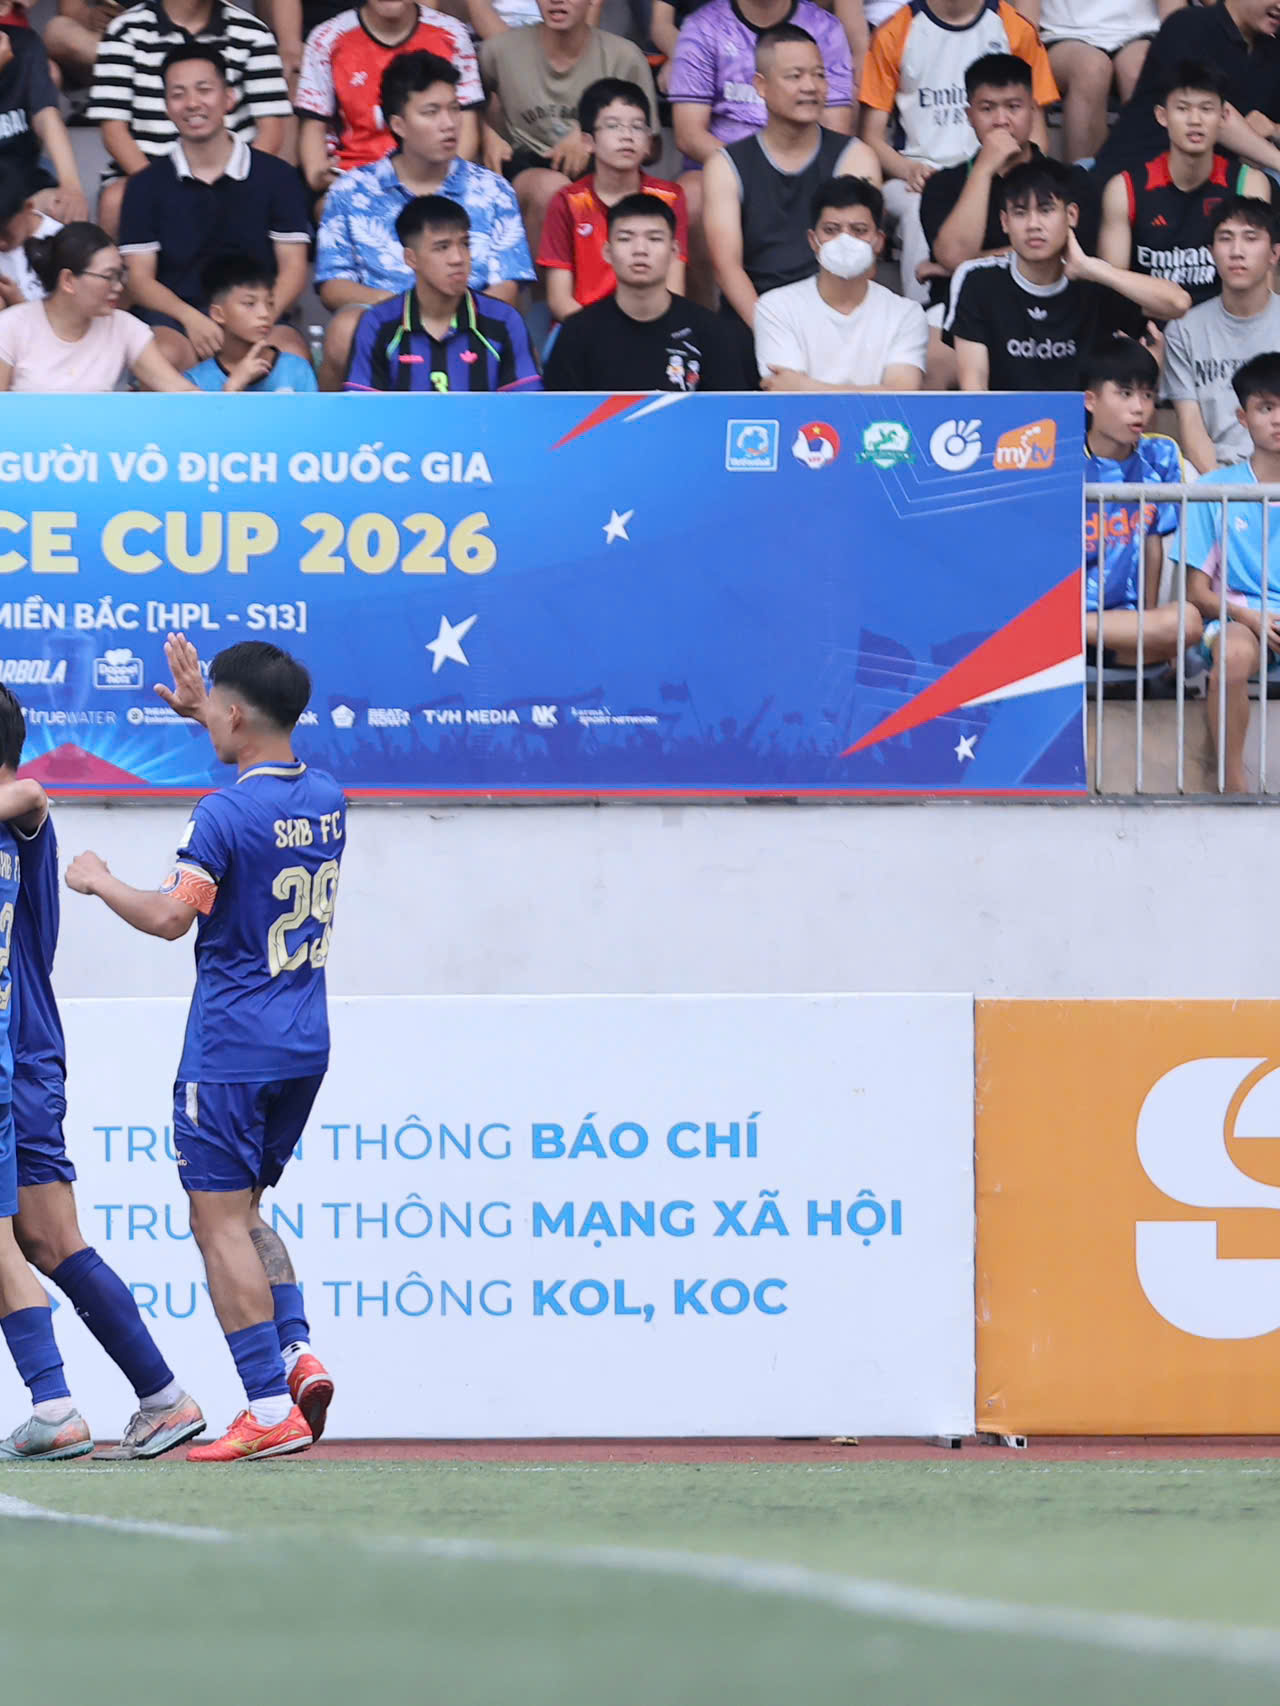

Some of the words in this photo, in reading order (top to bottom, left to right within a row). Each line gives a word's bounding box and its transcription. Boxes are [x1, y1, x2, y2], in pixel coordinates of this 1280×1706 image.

[109, 443, 168, 483] VÔ
[178, 451, 277, 492] ĐỊCH
[289, 441, 410, 483] QUỐC
[422, 451, 492, 483] GIA
[996, 442, 1055, 469] mytv
[101, 510, 279, 574] CUP
[299, 512, 497, 575] 2026
[74, 595, 139, 630] BẮC
[147, 601, 219, 632] [HPL
[247, 601, 307, 632] S13]
[465, 709, 520, 724] MEDIA
[273, 819, 313, 848] SHB
[320, 810, 342, 844] FC
[268, 859, 340, 978] 29
[322, 1114, 512, 1162] THÔNG
[531, 1111, 649, 1161] BÁO
[666, 1111, 761, 1160] CHÍ
[94, 1202, 305, 1241] TRUN
[322, 1192, 512, 1241] THÔNG
[531, 1199, 696, 1249] MẠNG
[714, 1189, 791, 1238] XÃ
[807, 1189, 903, 1248] HỘI
[322, 1271, 512, 1318] THÔNG
[532, 1279, 656, 1325] KOL,
[674, 1277, 789, 1317] KOC
